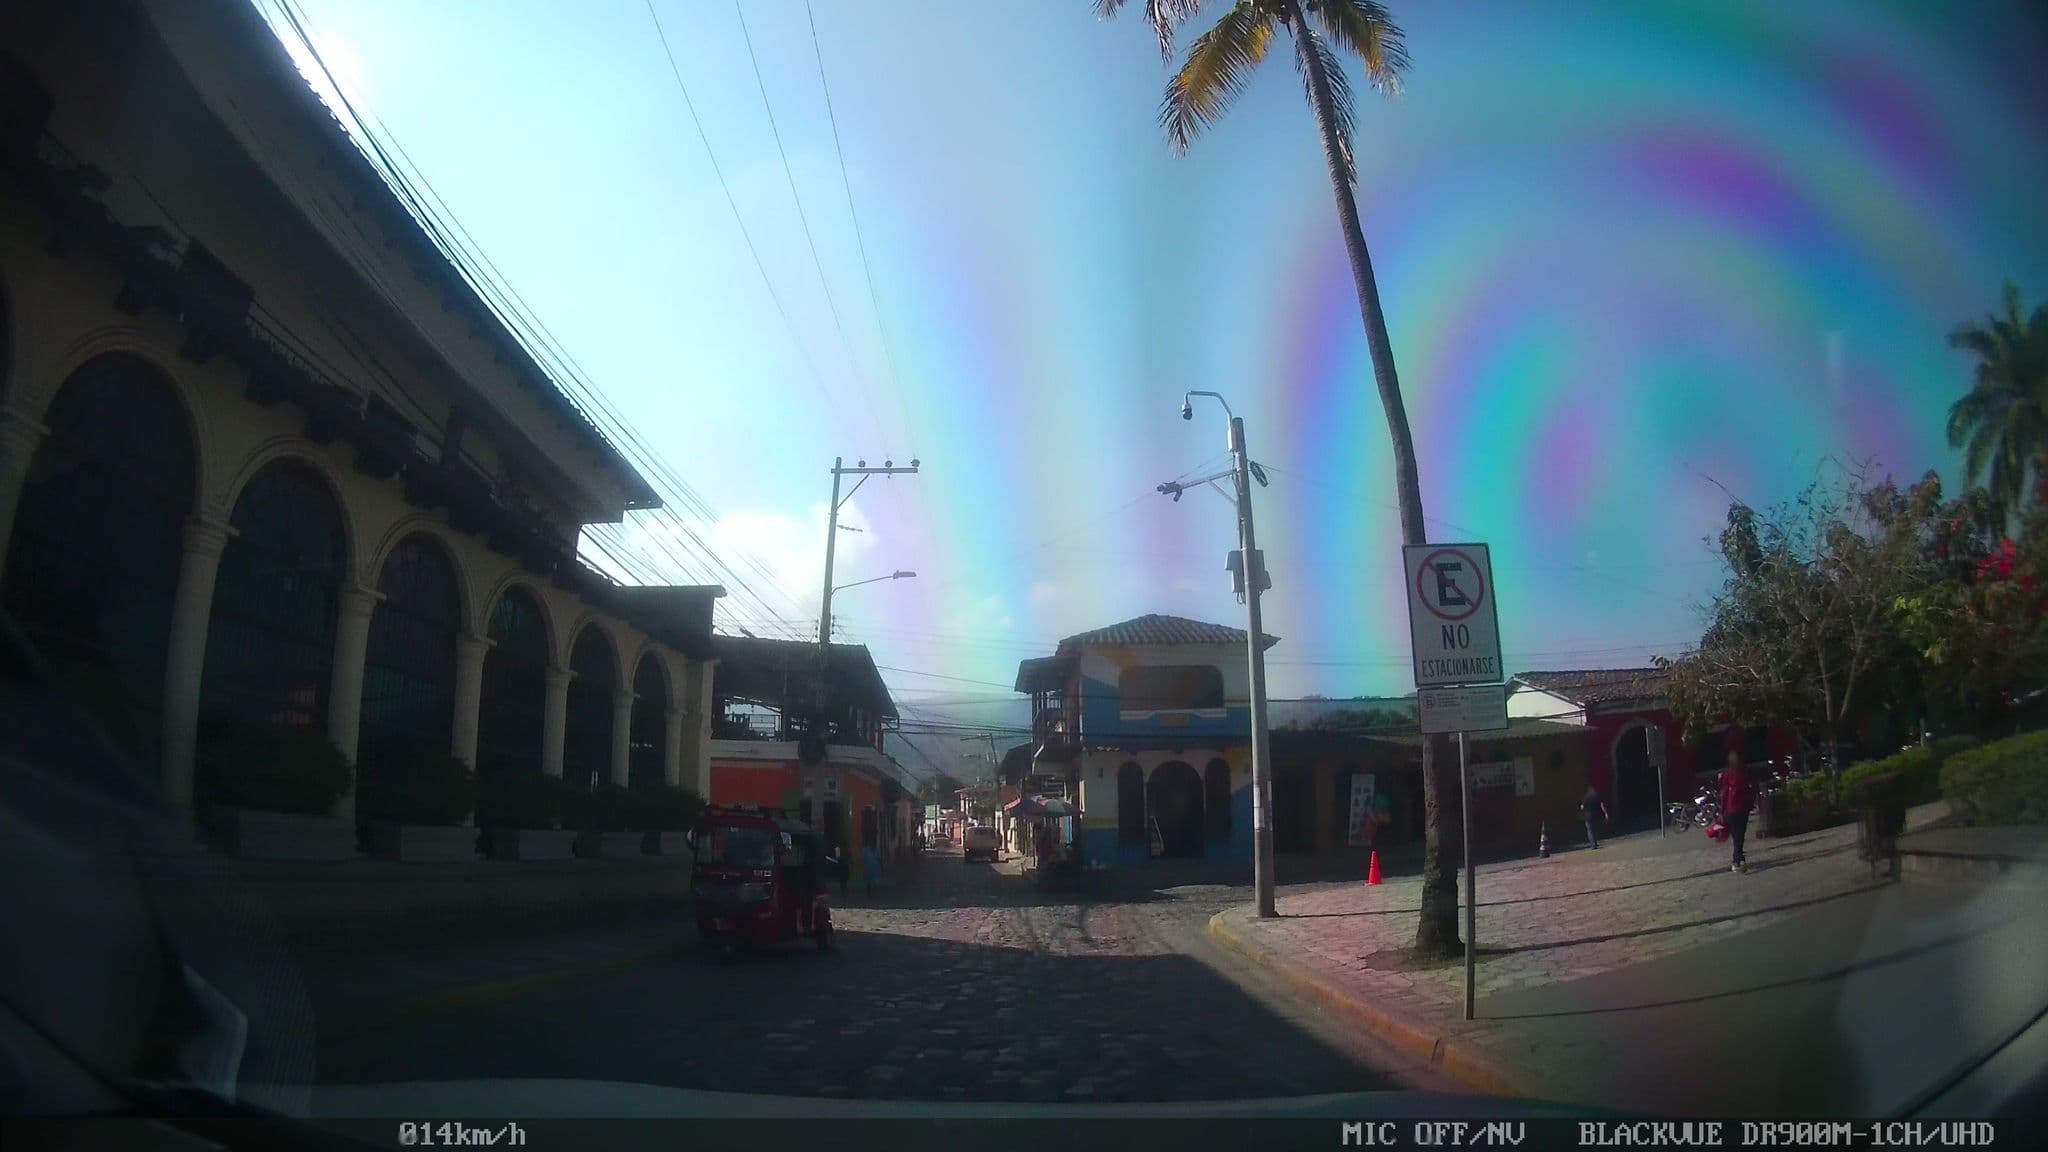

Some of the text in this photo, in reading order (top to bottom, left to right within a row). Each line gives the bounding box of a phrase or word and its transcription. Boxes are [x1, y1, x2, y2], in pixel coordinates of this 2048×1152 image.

[1437, 562, 1467, 606] E
[1442, 624, 1469, 650] NO
[1421, 656, 1495, 678] ESTACIONARSE
